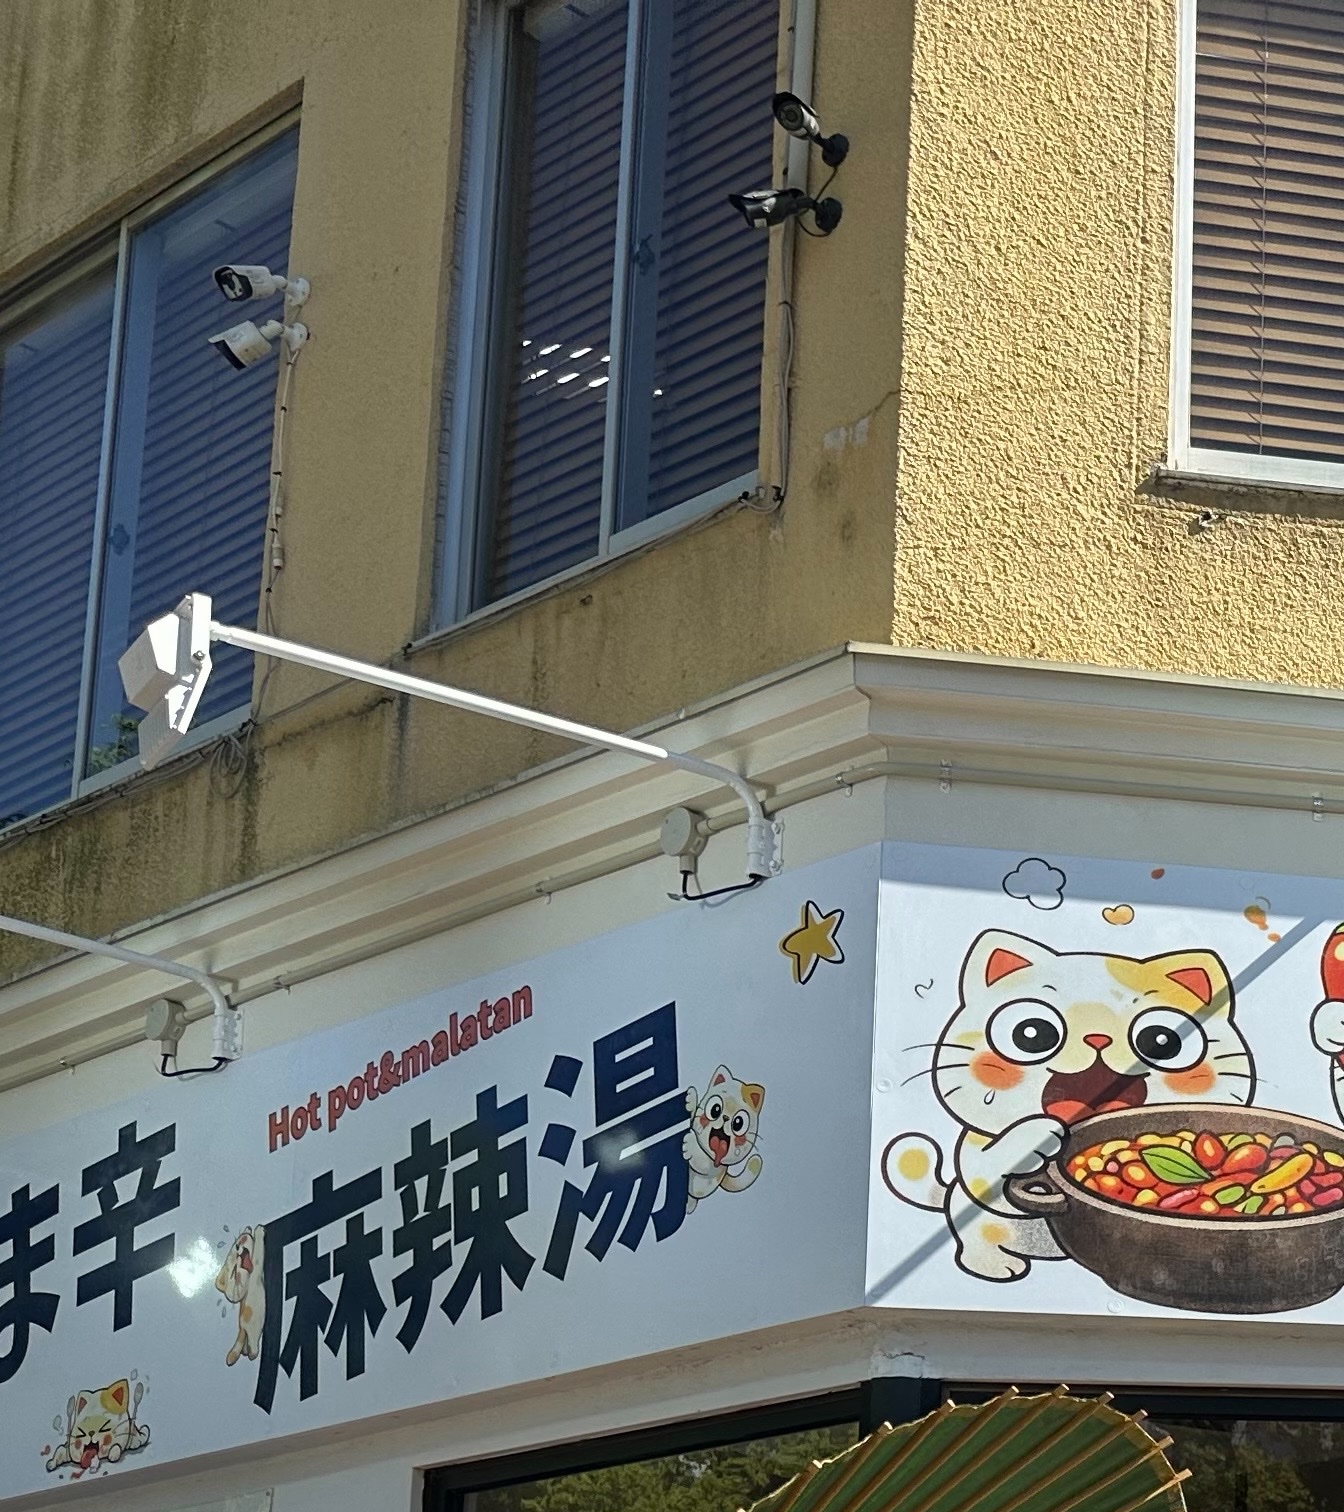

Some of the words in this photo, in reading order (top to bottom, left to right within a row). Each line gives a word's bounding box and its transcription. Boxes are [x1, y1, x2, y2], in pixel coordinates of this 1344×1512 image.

[253, 1000, 693, 1414] 麻辣湯
[268, 1091, 322, 1154] Hot
[328, 985, 533, 1133] pot&malatan
